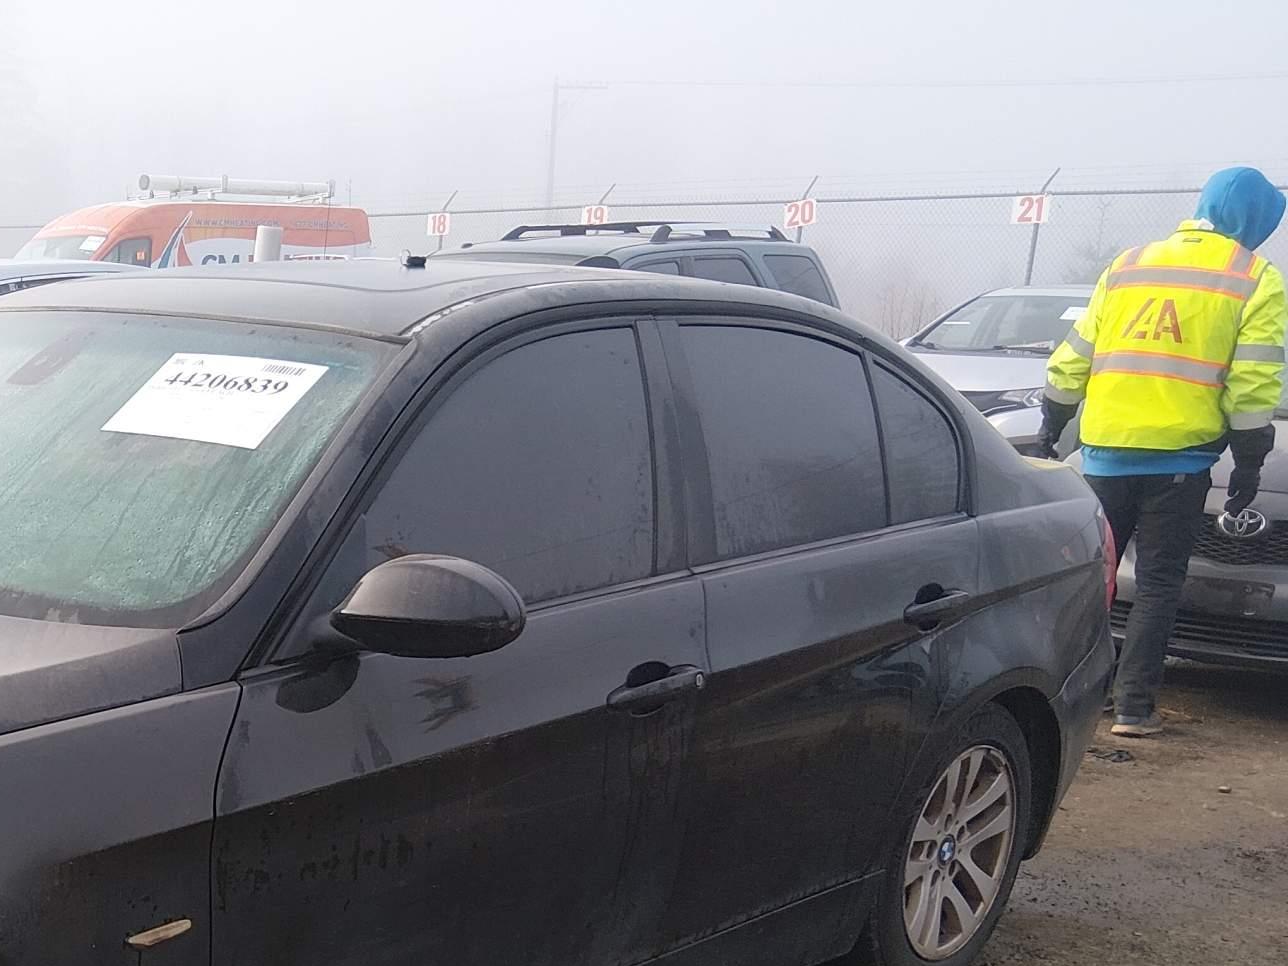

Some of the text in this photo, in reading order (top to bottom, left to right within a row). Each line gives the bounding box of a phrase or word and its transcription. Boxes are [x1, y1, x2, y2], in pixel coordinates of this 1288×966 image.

[585, 206, 605, 225] 19
[786, 200, 813, 226] 20
[1016, 196, 1045, 223] 21
[431, 214, 447, 234] 18
[164, 371, 289, 395] 44206839
